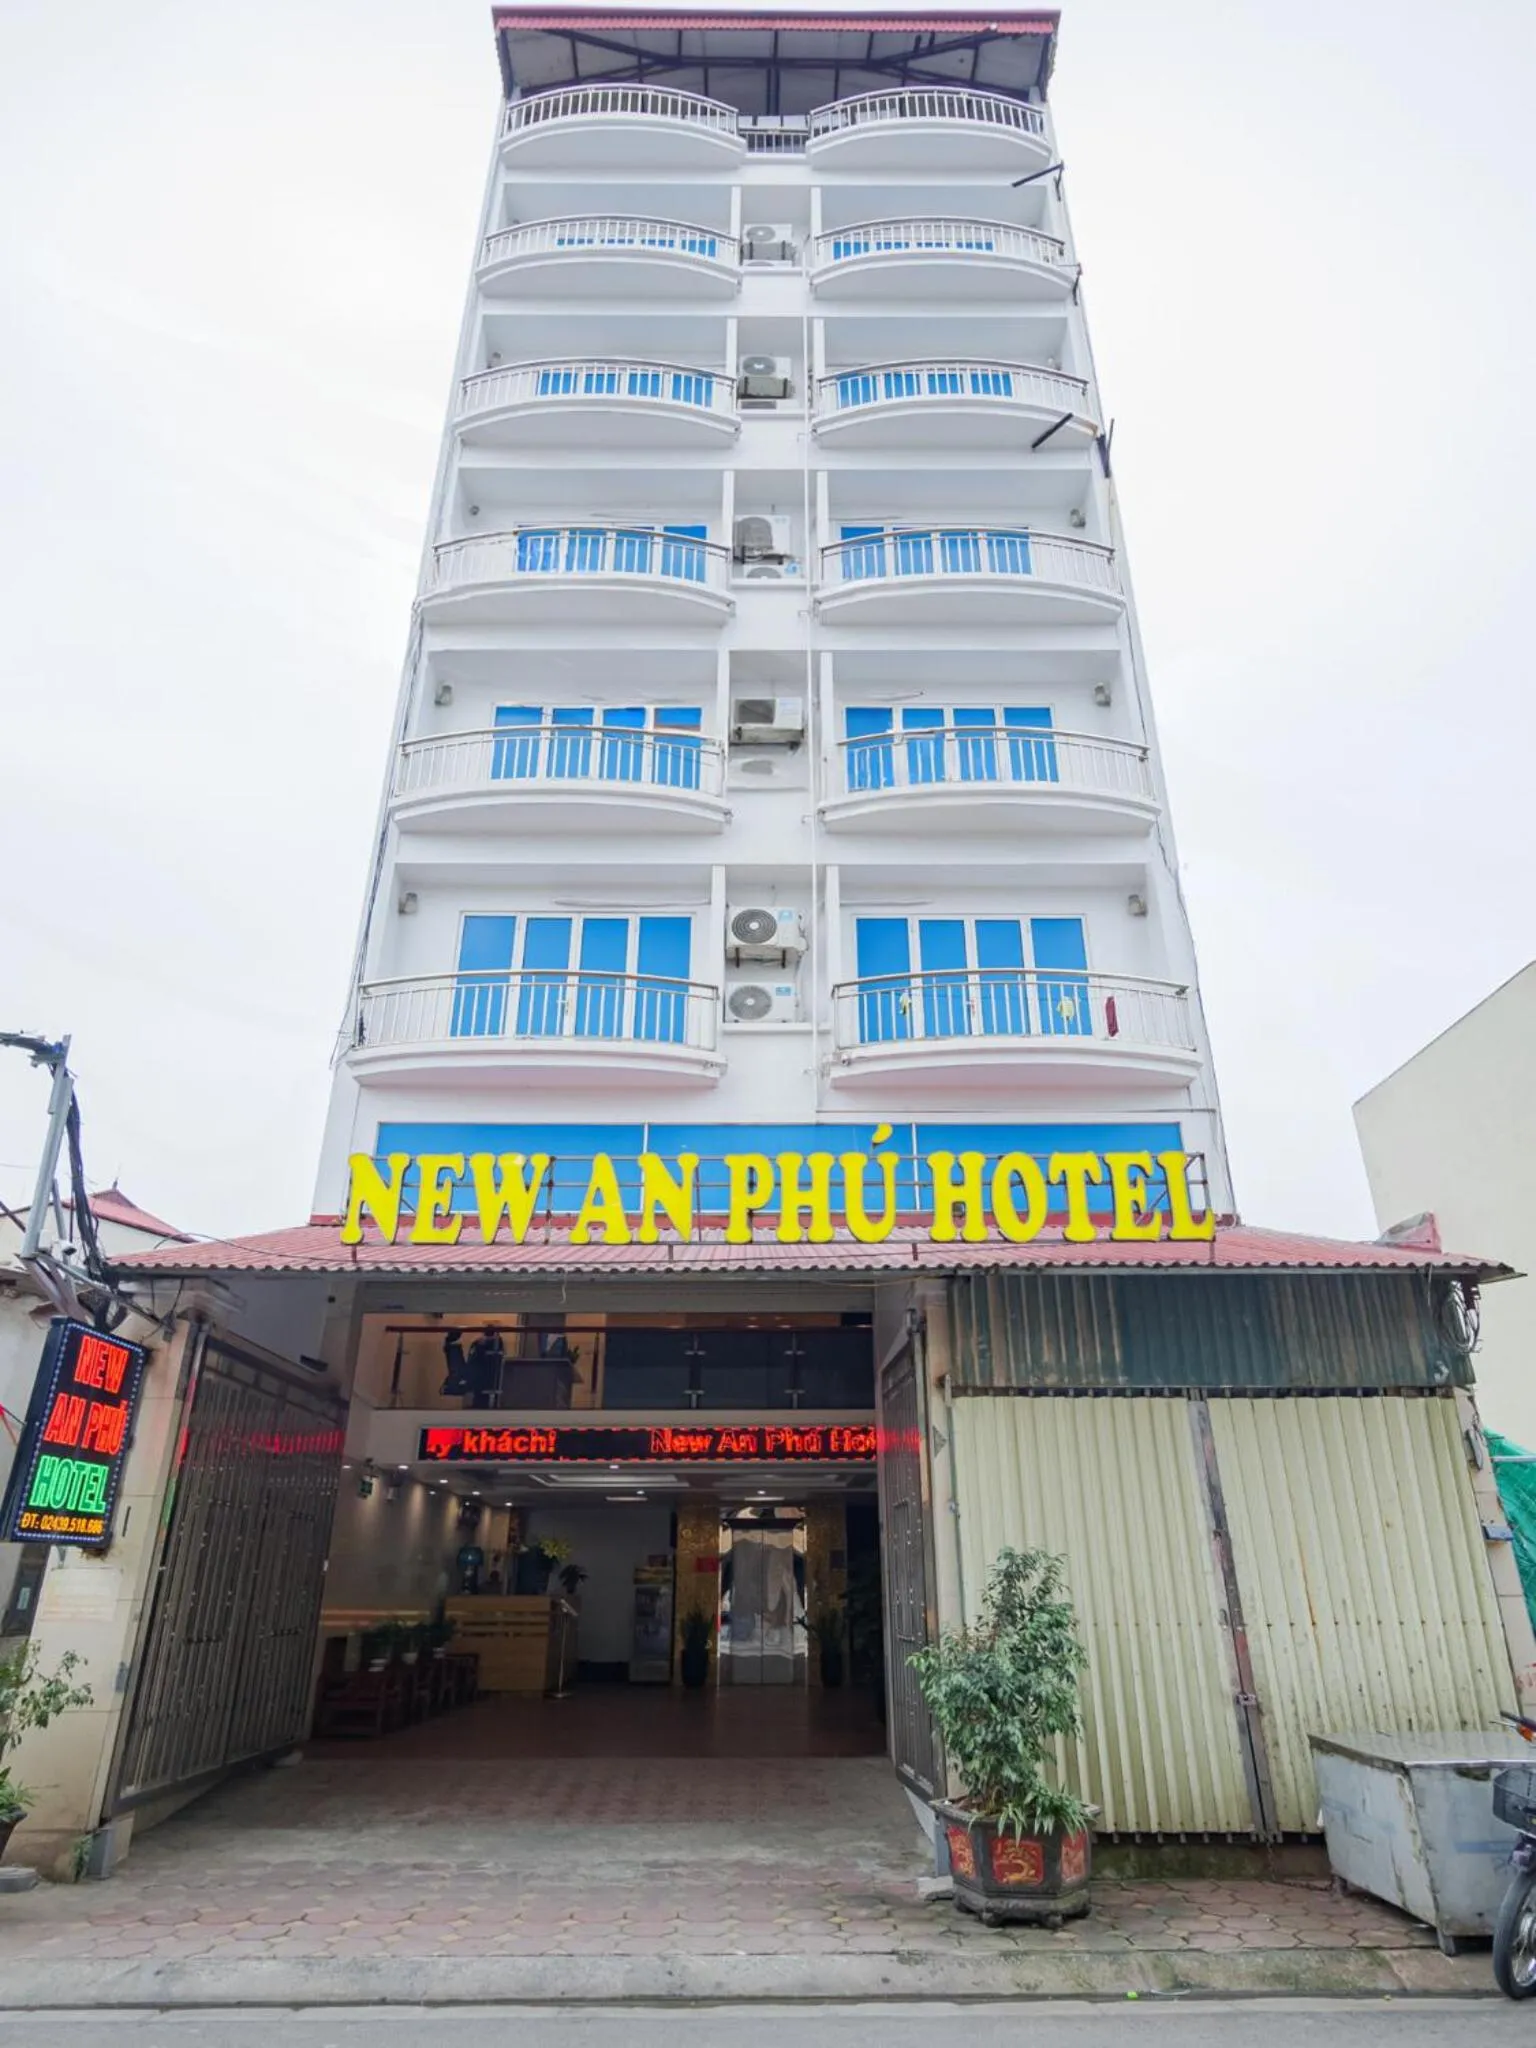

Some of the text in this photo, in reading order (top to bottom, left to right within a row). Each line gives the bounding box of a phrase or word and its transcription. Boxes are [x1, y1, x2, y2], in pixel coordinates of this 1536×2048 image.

[340, 1124, 1215, 1244] NEW AN PHÚ HOTEL
[74, 1335, 129, 1393] NEW
[44, 1393, 128, 1455] AN PHÚ
[650, 1428, 714, 1454] New
[716, 1429, 758, 1454] An
[29, 1454, 109, 1513] HOTEL
